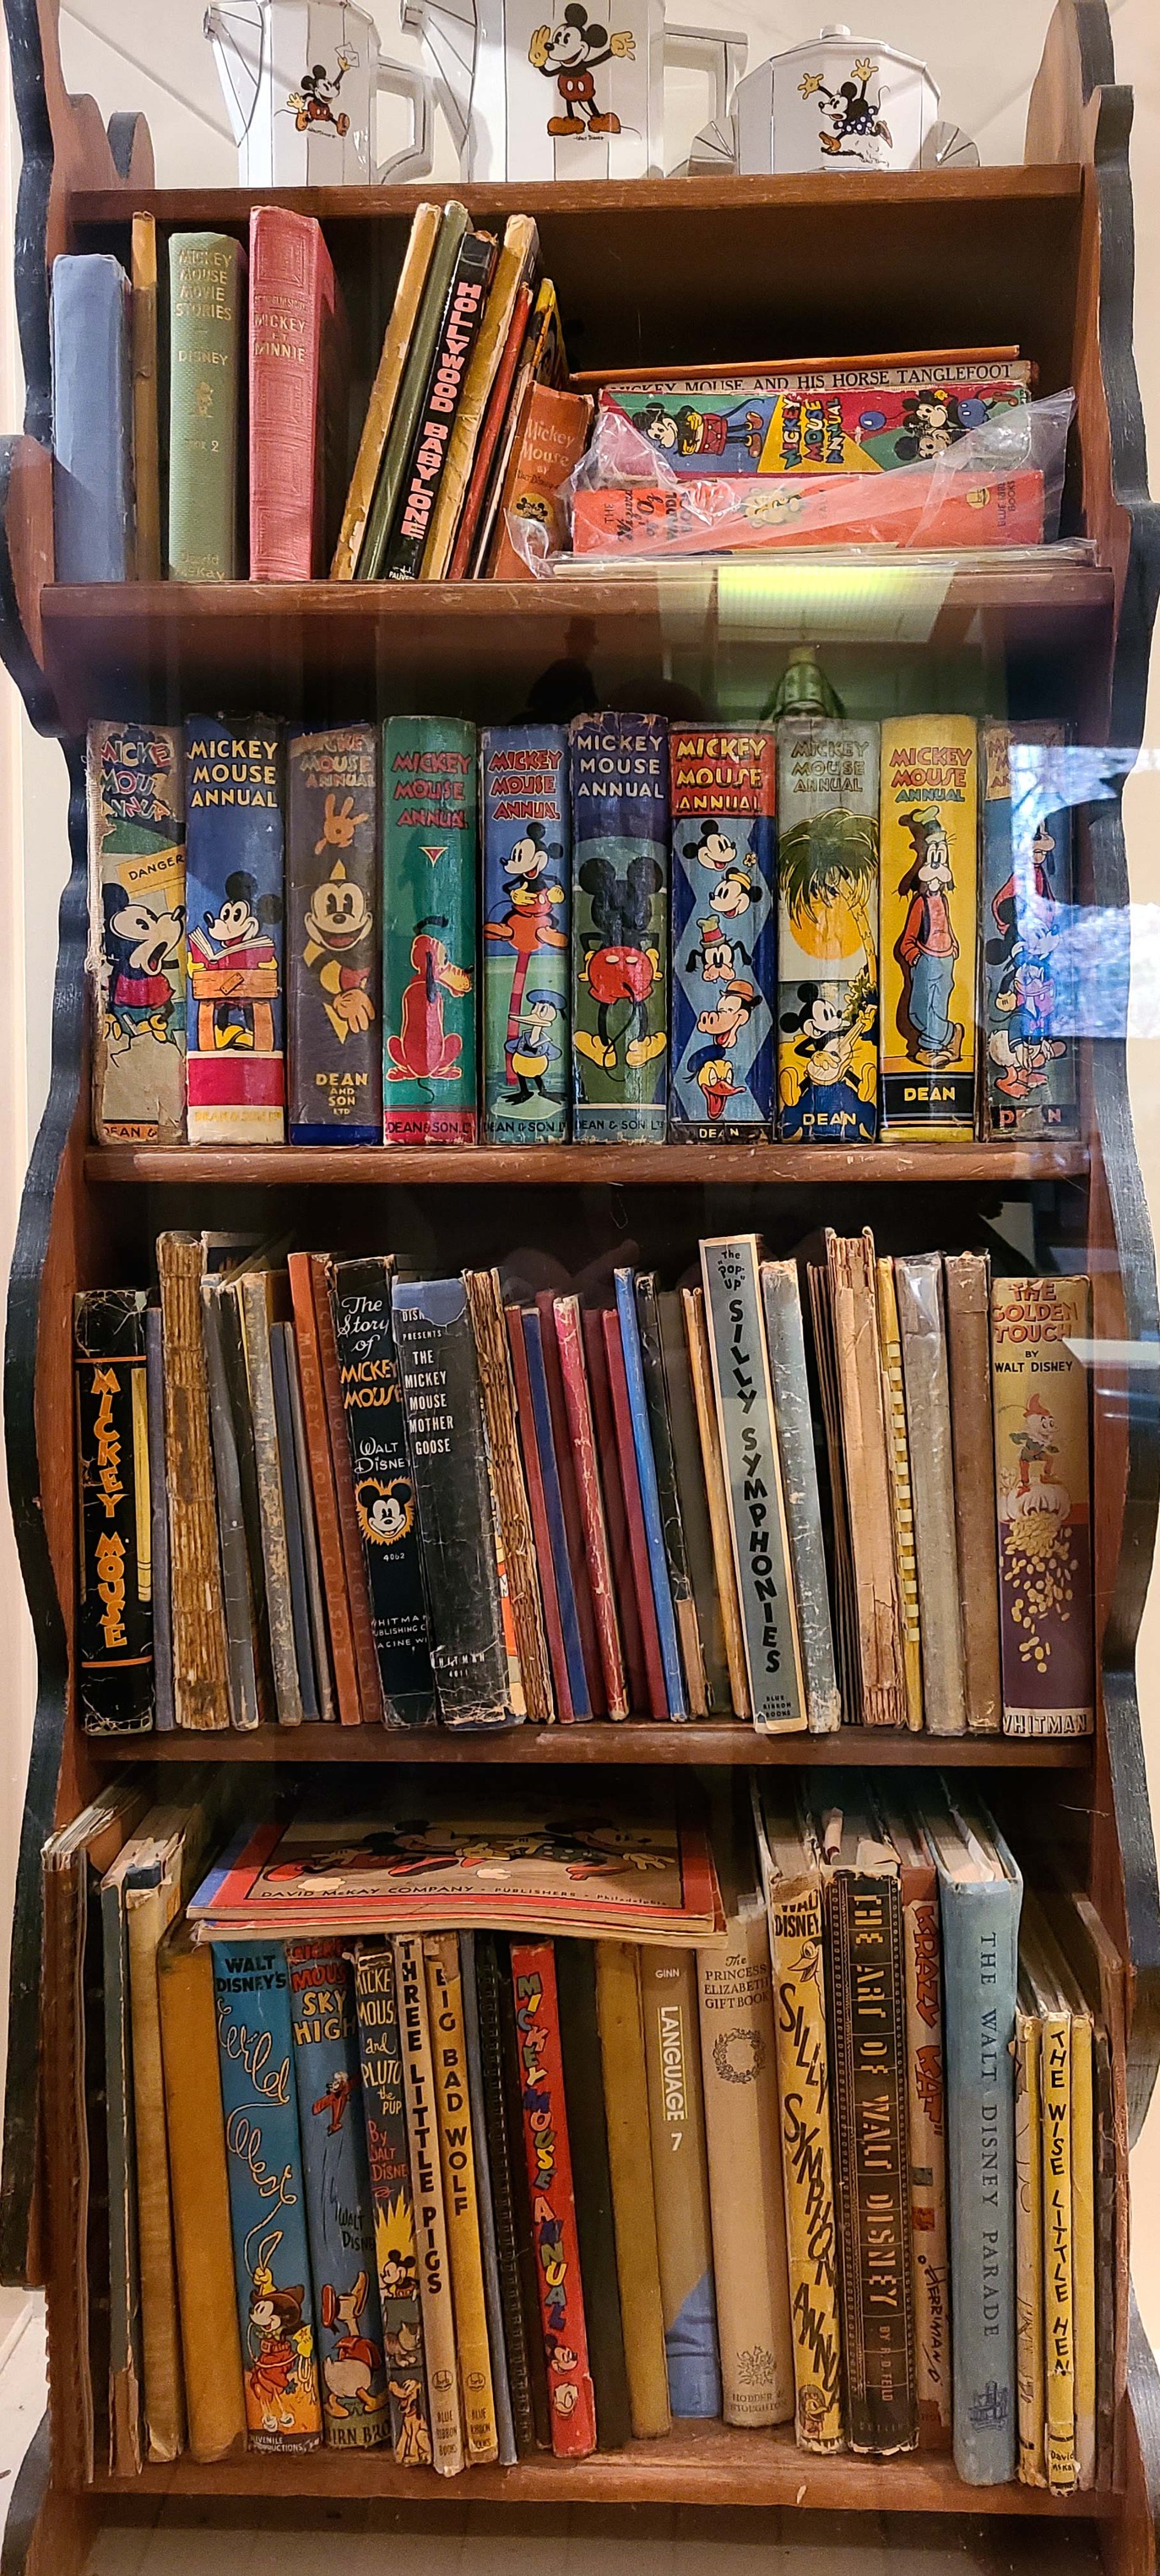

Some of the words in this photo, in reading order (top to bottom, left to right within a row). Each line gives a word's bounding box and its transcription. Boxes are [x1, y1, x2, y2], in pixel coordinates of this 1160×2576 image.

[178, 248, 232, 268] MICKEY
[179, 267, 228, 285] MOUSE
[180, 285, 225, 301] MOVIE
[175, 302, 232, 321] STORIES
[254, 312, 306, 334] MICKEY
[178, 350, 228, 366] DISNEY
[254, 339, 306, 362] MINNIE
[429, 281, 482, 413] HOLLYWOOD
[685, 379, 745, 391] MOUSE
[753, 377, 789, 389] AND
[797, 375, 825, 388] HIS
[832, 371, 889, 388] HORSE
[897, 364, 1012, 384] TANGLEFOOT
[523, 418, 575, 449] Mickey
[779, 398, 803, 469] MICKEY
[803, 399, 825, 463] MOUSE
[825, 397, 845, 464] ANNUAL
[211, 440, 220, 452] 2
[523, 440, 570, 467] Mouse
[400, 421, 449, 540] BABYLONE
[604, 503, 614, 523] THE
[188, 739, 279, 760] MICKEY
[577, 734, 664, 753] MICKEY
[675, 736, 767, 762] MICKEY
[790, 740, 870, 758] MICKEY
[299, 754, 372, 773] MOUSE
[391, 751, 472, 775] MICKEY
[487, 748, 564, 774] MICKEY
[579, 757, 661, 775] MOUSE
[888, 746, 973, 767] MICKEY
[192, 764, 277, 785] MOUSE
[675, 767, 763, 789] MOUSE
[791, 761, 865, 777] MOUSE
[891, 767, 967, 789] MOUSE
[306, 773, 376, 788] ANNUAL
[393, 778, 466, 801] MOUSE
[489, 774, 557, 798] MOUSE
[577, 782, 665, 800] ANNUAL
[793, 778, 864, 793] ANNUAL
[190, 789, 279, 808] ANNUAL
[676, 794, 763, 813] ANNUAL
[894, 789, 966, 804] ANNUAL
[396, 807, 469, 831] ANNUAL
[492, 800, 562, 822] ANNUAL
[127, 854, 185, 881] DANGER
[315, 1072, 369, 1087] DEAN
[328, 1096, 355, 1107] SON
[330, 1087, 355, 1096] AND
[903, 1086, 956, 1102] DEAN
[333, 1107, 350, 1115] LTD
[803, 1112, 857, 1125] DEAN
[386, 1121, 423, 1135] DEAN
[432, 1121, 458, 1133] SON
[483, 1121, 514, 1134] DEAN
[529, 1121, 550, 1133] SON
[574, 1120, 606, 1131] DEAN
[610, 1120, 617, 1131] &
[621, 1119, 645, 1131] SON
[698, 1127, 740, 1139] DEAN
[721, 1250, 741, 1260] The
[1008, 1281, 1057, 1303] THE
[341, 1296, 382, 1315] The
[991, 1301, 1078, 1323] GOLDEN
[337, 1314, 390, 1338] Story
[402, 1328, 443, 1342] PRESENTS
[994, 1322, 1072, 1344] TOUCH
[351, 1334, 381, 1360] of
[412, 1349, 435, 1366] THE
[728, 1298, 758, 1414] SILLY
[1025, 1350, 1039, 1359] BY
[339, 1359, 398, 1385] MICKEY
[995, 1362, 1025, 1373] WALT
[1031, 1361, 1073, 1372] DISNEY
[404, 1369, 447, 1390] MICKEY
[344, 1383, 404, 1411] MOUSE
[409, 1392, 447, 1411] MOUSE
[408, 1414, 454, 1434] MOTHER
[90, 1366, 130, 1518] MICKEY
[359, 1436, 398, 1456] WALT
[415, 1437, 452, 1456] GOOSE
[740, 1426, 781, 1673] SYMPHONIES
[95, 1530, 128, 1650] MOUSE
[377, 1639, 411, 1649] ACINE
[762, 1701, 792, 1710] RIBBON
[765, 1710, 791, 1718] BOOKS
[321, 1888, 380, 1896] McKAY
[388, 1885, 474, 1895] COMPANY
[494, 1887, 577, 1897] PUBLISHERS
[596, 1894, 668, 1906] Philadelphia
[774, 1912, 820, 1938] DISNEY
[854, 1894, 883, 1944] THE
[224, 1955, 276, 1976] WALT
[725, 1954, 748, 1968] The
[913, 1905, 941, 2029] KRAZY
[980, 1932, 997, 1987] THE
[216, 1971, 287, 1993] DISNEY'S
[654, 1967, 680, 1979] GINN
[705, 1963, 767, 1982] PRINCESS
[398, 1939, 422, 2052] THREE
[703, 1977, 769, 1995] ELIZABETH
[856, 1964, 886, 2019] ART
[301, 1988, 347, 2016] SKY
[436, 1967, 457, 2031] BIG
[293, 2016, 356, 2046] HIGH
[516, 1972, 549, 2087] MICKEY
[365, 2032, 396, 2055] and
[778, 1982, 827, 2115] SILLY
[981, 2007, 998, 2082] WALT
[661, 2005, 686, 2122] LANGUAGE
[859, 2041, 890, 2074] OF
[1049, 2029, 1067, 2089] THE
[360, 2059, 402, 2088] PLUTO
[442, 2048, 463, 2112] BAD
[377, 2085, 397, 2101] the
[382, 2100, 403, 2115] PUP
[368, 2120, 388, 2145] By
[410, 2064, 435, 2194] LITTLE
[523, 2088, 557, 2191] MOUSE
[861, 2094, 892, 2170] WALT
[1048, 2103, 1066, 2177] WISE
[670, 2132, 684, 2151] 7
[369, 2147, 397, 2162] WALT
[981, 2104, 999, 2208] DISNEY
[445, 2125, 469, 2217] WOLF
[339, 2206, 365, 2231] WALT
[422, 2205, 442, 2295] PIGS
[865, 2194, 898, 2308] DISNEY
[1052, 2188, 1070, 2303] LITTLE
[534, 2195, 568, 2331] ANNUAL
[982, 2228, 1000, 2337] PARADE
[878, 2325, 891, 2340] BY
[1053, 2316, 1071, 2377] HEN
[732, 2393, 773, 2403] HODDER
[438, 2410, 453, 2424] BLUE
